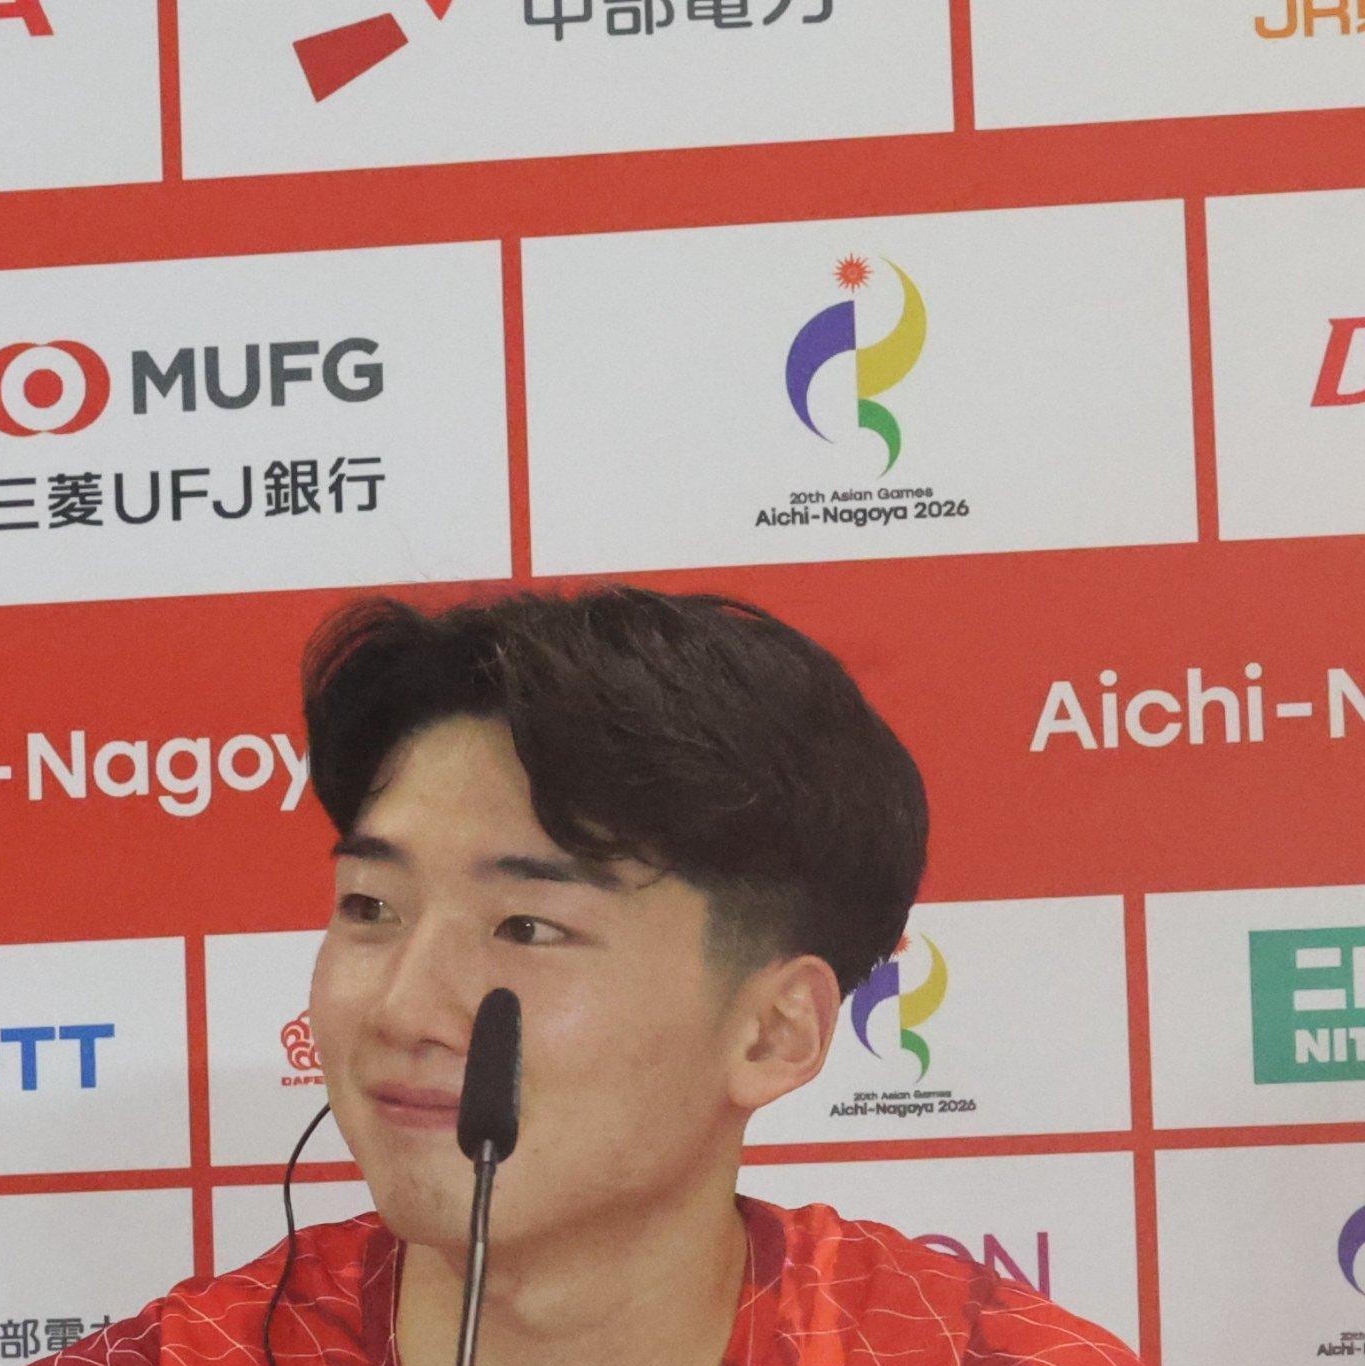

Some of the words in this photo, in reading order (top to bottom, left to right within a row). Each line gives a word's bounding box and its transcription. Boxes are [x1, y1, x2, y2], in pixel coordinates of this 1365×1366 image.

[131, 337, 385, 415] MUFG
[789, 491, 825, 504] 20th
[830, 488, 873, 502] Asian
[877, 487, 933, 500] Games
[755, 505, 908, 527] Aichi-Nagoya
[914, 499, 969, 519] 2026
[1293, 945, 1365, 1012] ニ
[830, 1102, 934, 1118] Aichi-Nagoya
[938, 1099, 976, 1113] 2026
[1316, 1341, 1365, 1357] Aichi-
